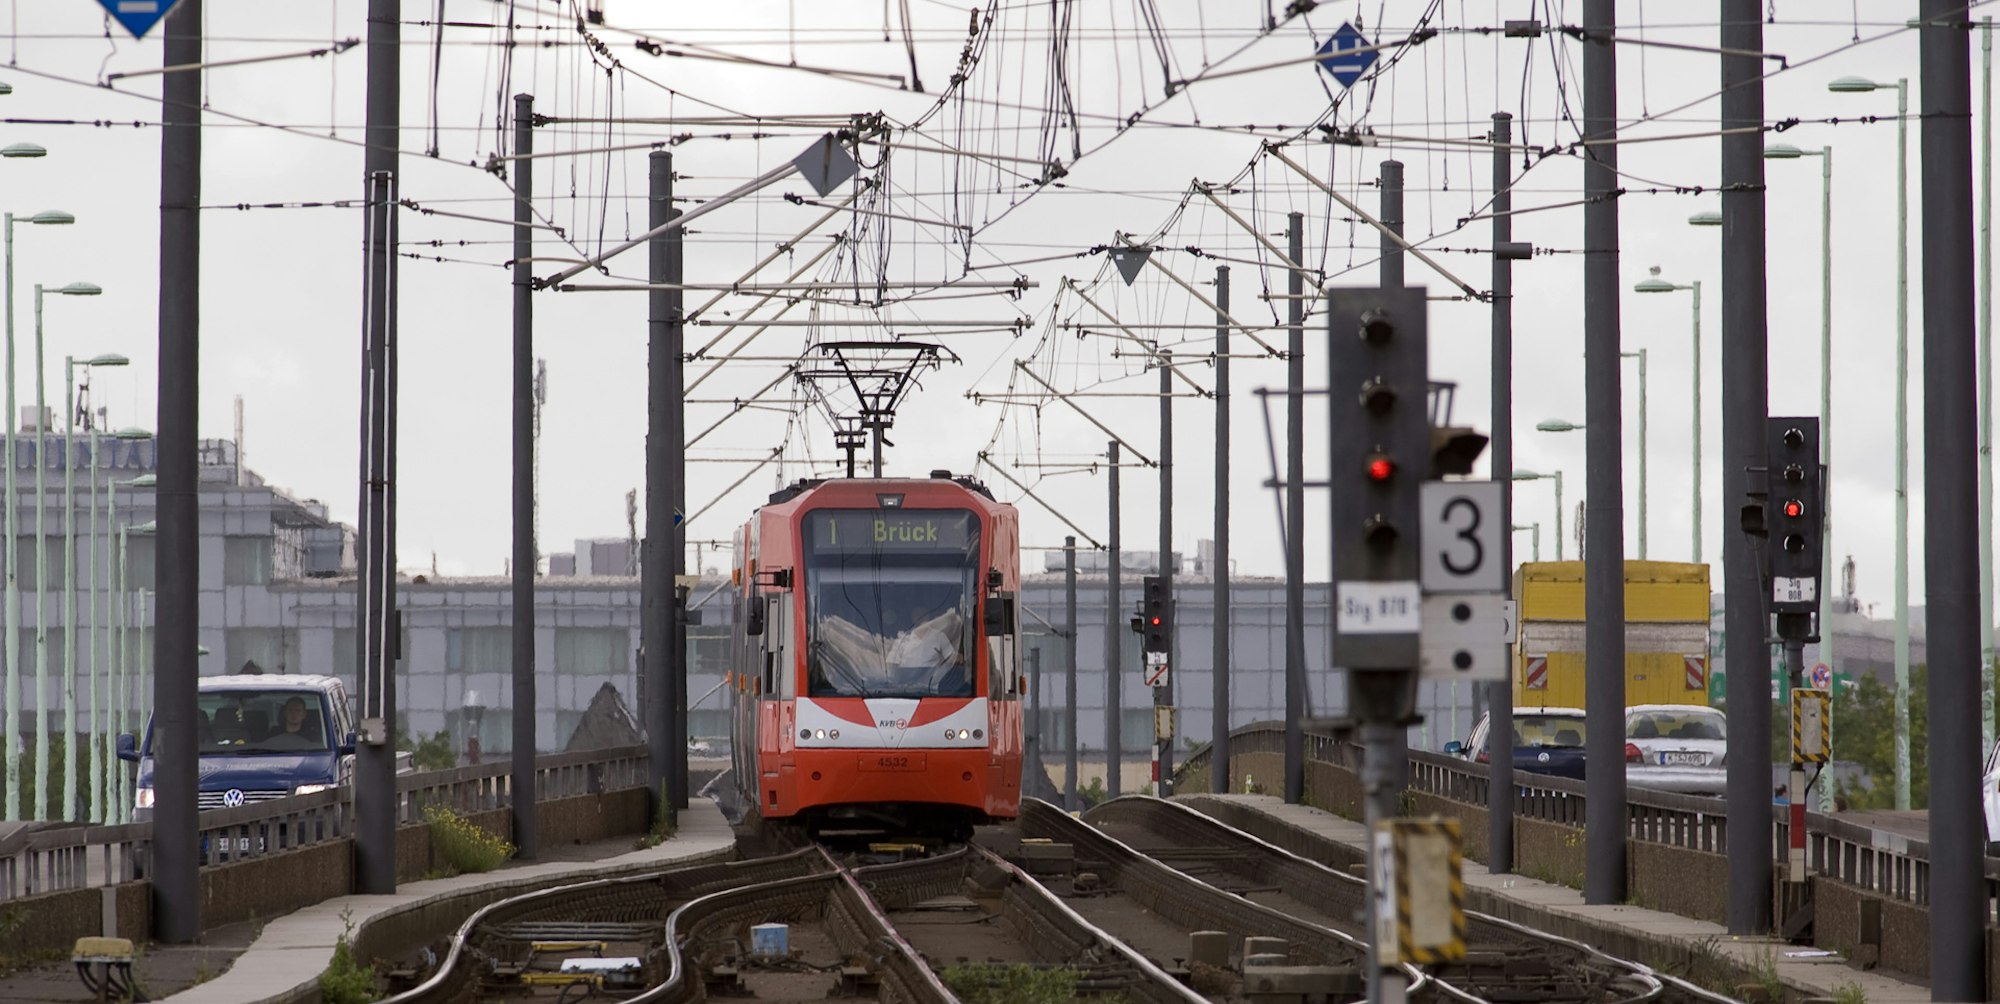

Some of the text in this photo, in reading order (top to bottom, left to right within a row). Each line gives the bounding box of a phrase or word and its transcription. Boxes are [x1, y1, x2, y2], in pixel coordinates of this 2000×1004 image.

[830, 518, 937, 545] 1 Brück
[1441, 495, 1483, 576] 3
[1789, 576, 1801, 590] Sig
[1345, 597, 1372, 623] Sig
[879, 719, 896, 728] KVB
[877, 757, 908, 768] 4532
